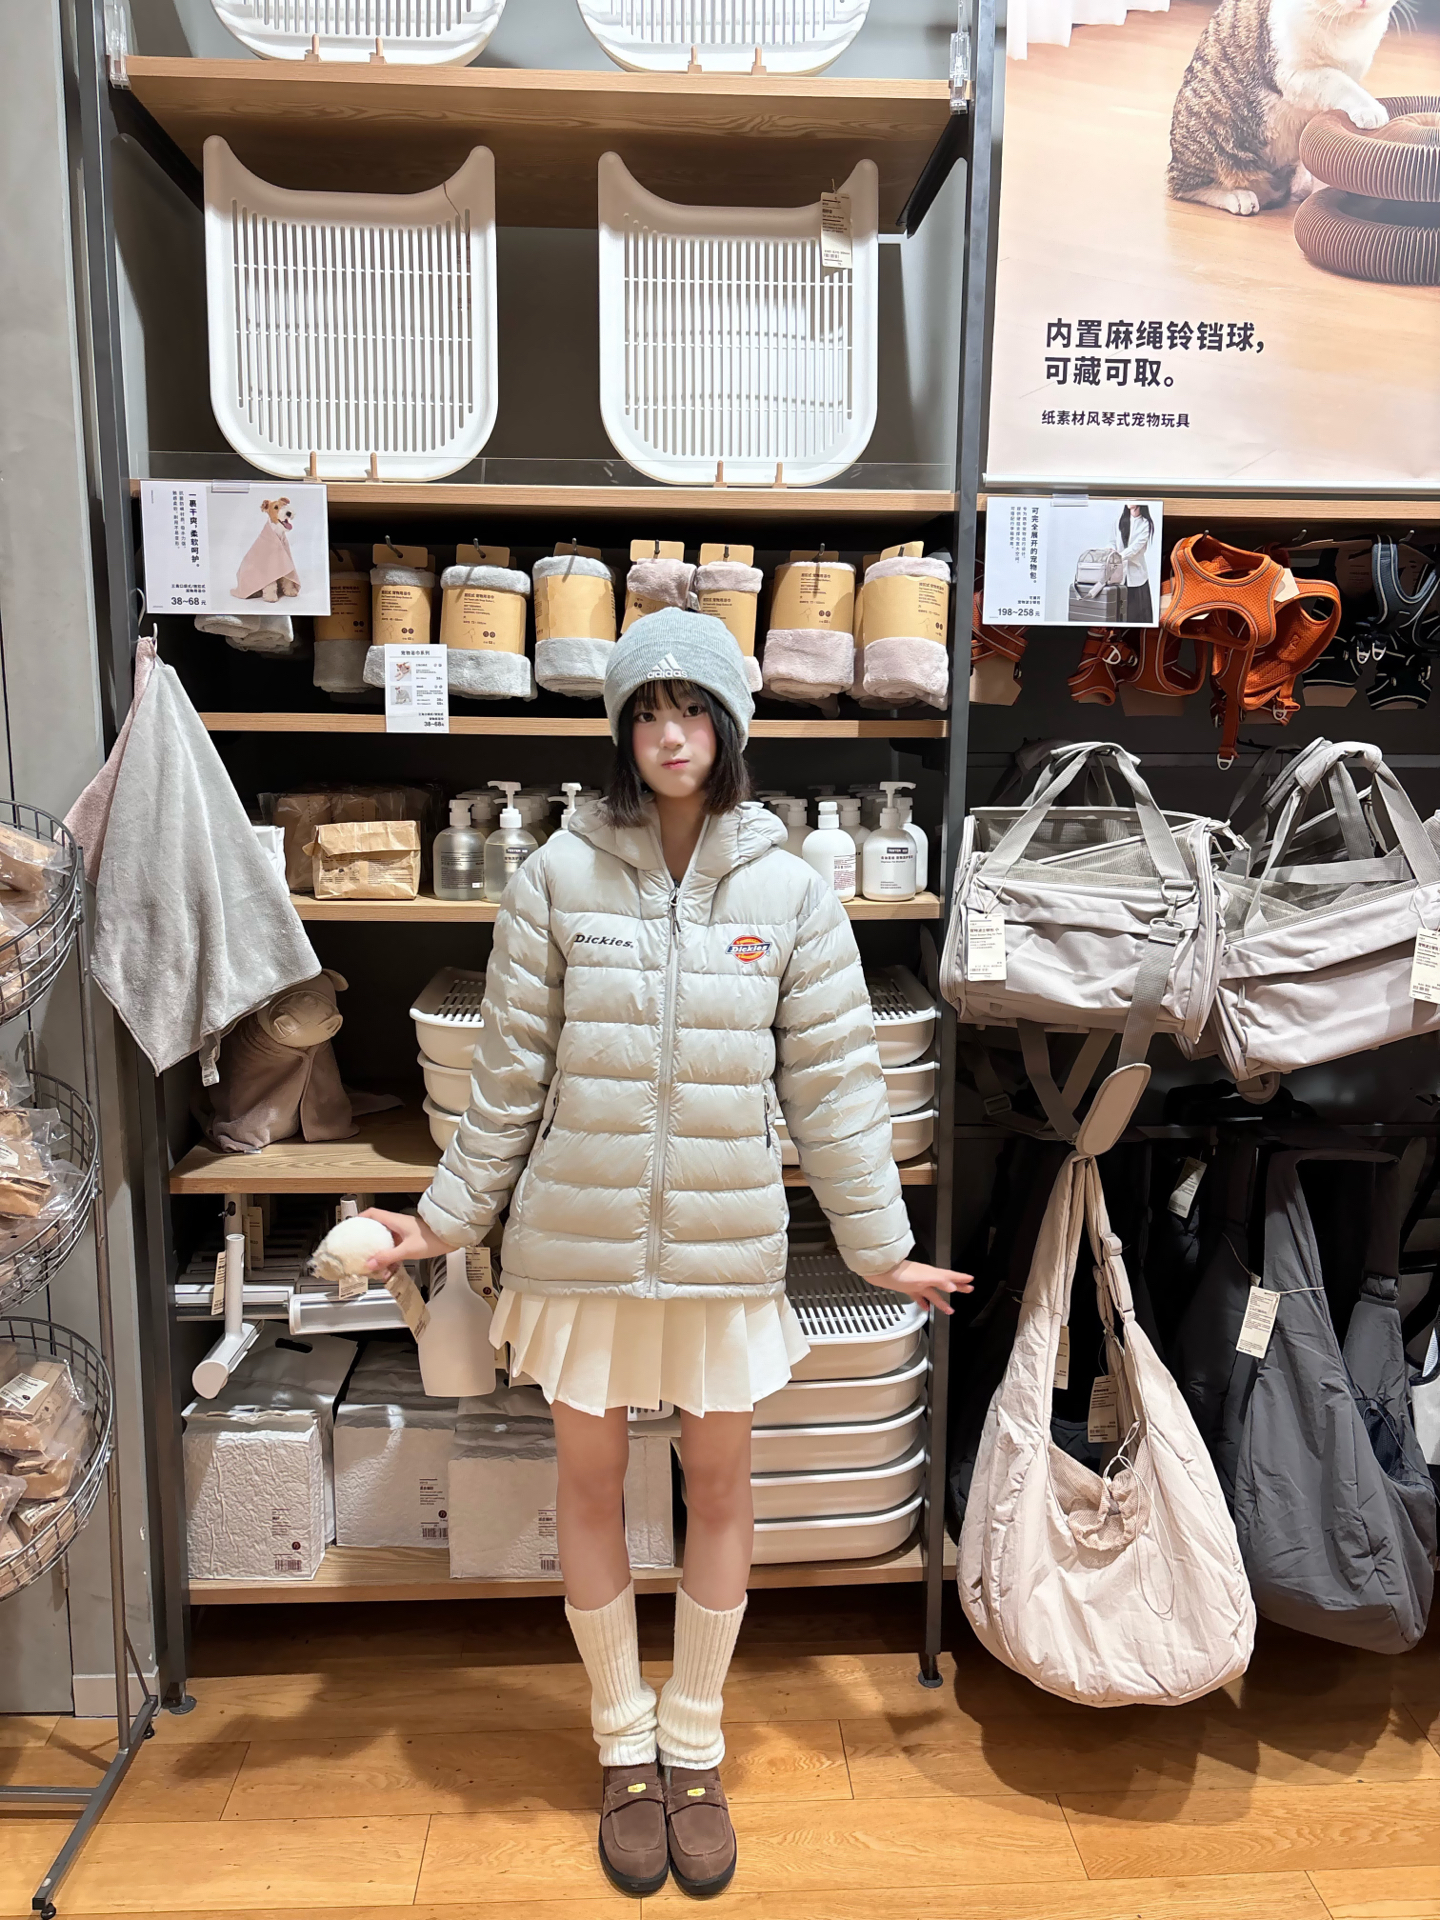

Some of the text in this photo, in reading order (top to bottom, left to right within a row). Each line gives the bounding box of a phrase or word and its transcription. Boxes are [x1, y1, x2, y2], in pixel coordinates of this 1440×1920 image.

[1046, 318, 1264, 353] 内置麻绳铃铛球，
[1045, 356, 1174, 388] 可藏可取。
[1041, 410, 1190, 428] 纸素材风琴式宠物玩具
[188, 493, 200, 567] 一裹干爽，柔软呵护。
[1029, 507, 1040, 584] 可完全展开的宠物包。
[171, 597, 200, 606] 38~68
[997, 608, 1034, 616] 198~258
[647, 670, 688, 679] adidas
[573, 934, 633, 948] Dickies
[731, 944, 768, 953] Dickies
